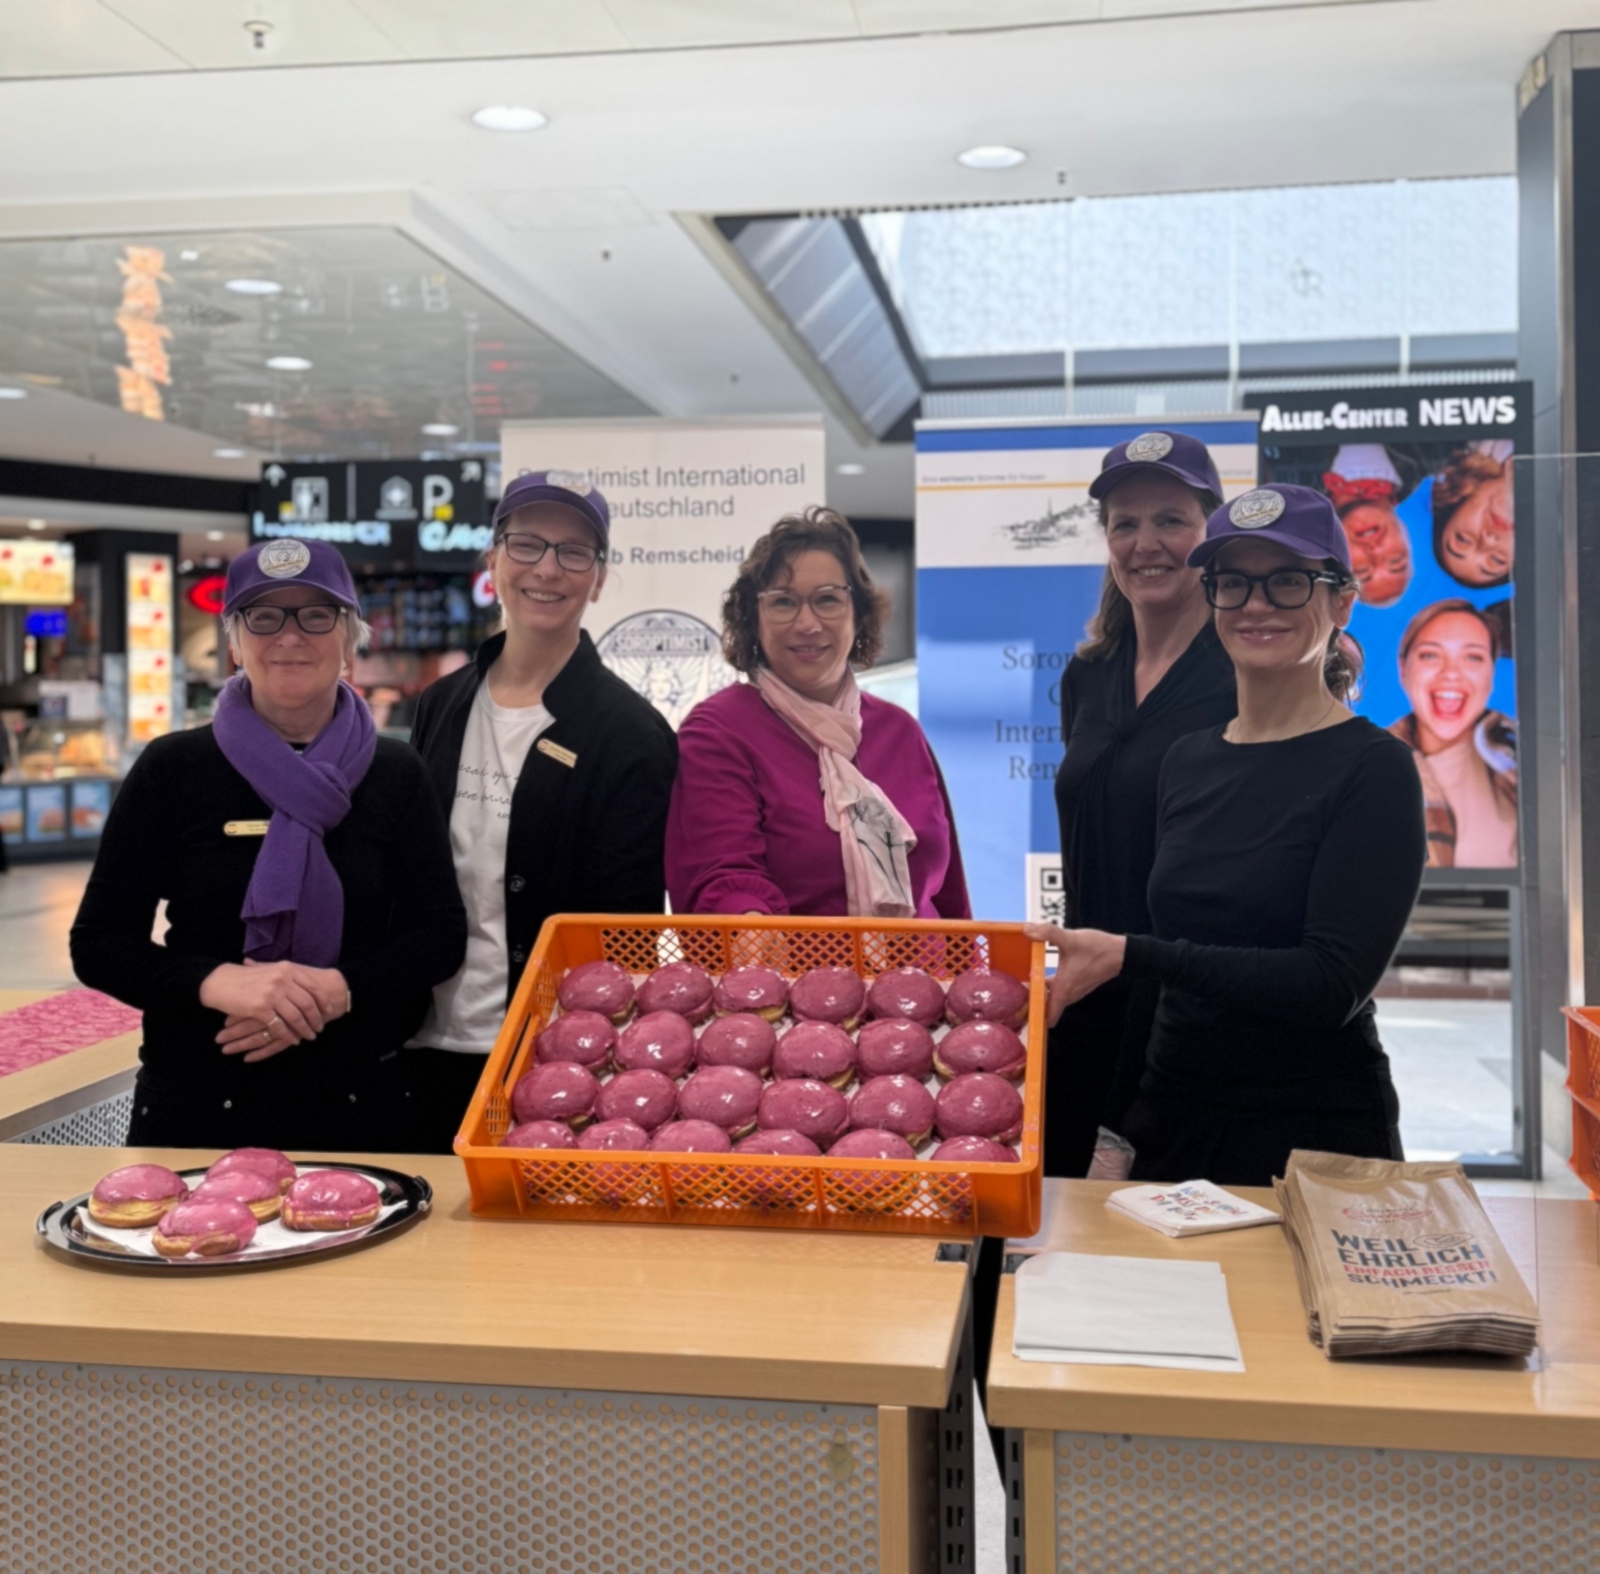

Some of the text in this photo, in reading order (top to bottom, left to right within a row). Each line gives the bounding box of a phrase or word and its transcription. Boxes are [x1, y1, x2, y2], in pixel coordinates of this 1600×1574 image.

[1418, 396, 1516, 426] NEWS
[655, 463, 806, 488] International
[607, 496, 735, 520] eutschland
[630, 547, 745, 566] Remscheid
[1330, 1228, 1419, 1253] WEIL
[1337, 1244, 1485, 1268] EHRLICH
[1343, 1260, 1490, 1278] EINFACH BESSER
[1347, 1270, 1499, 1289] SCHMECKT!
